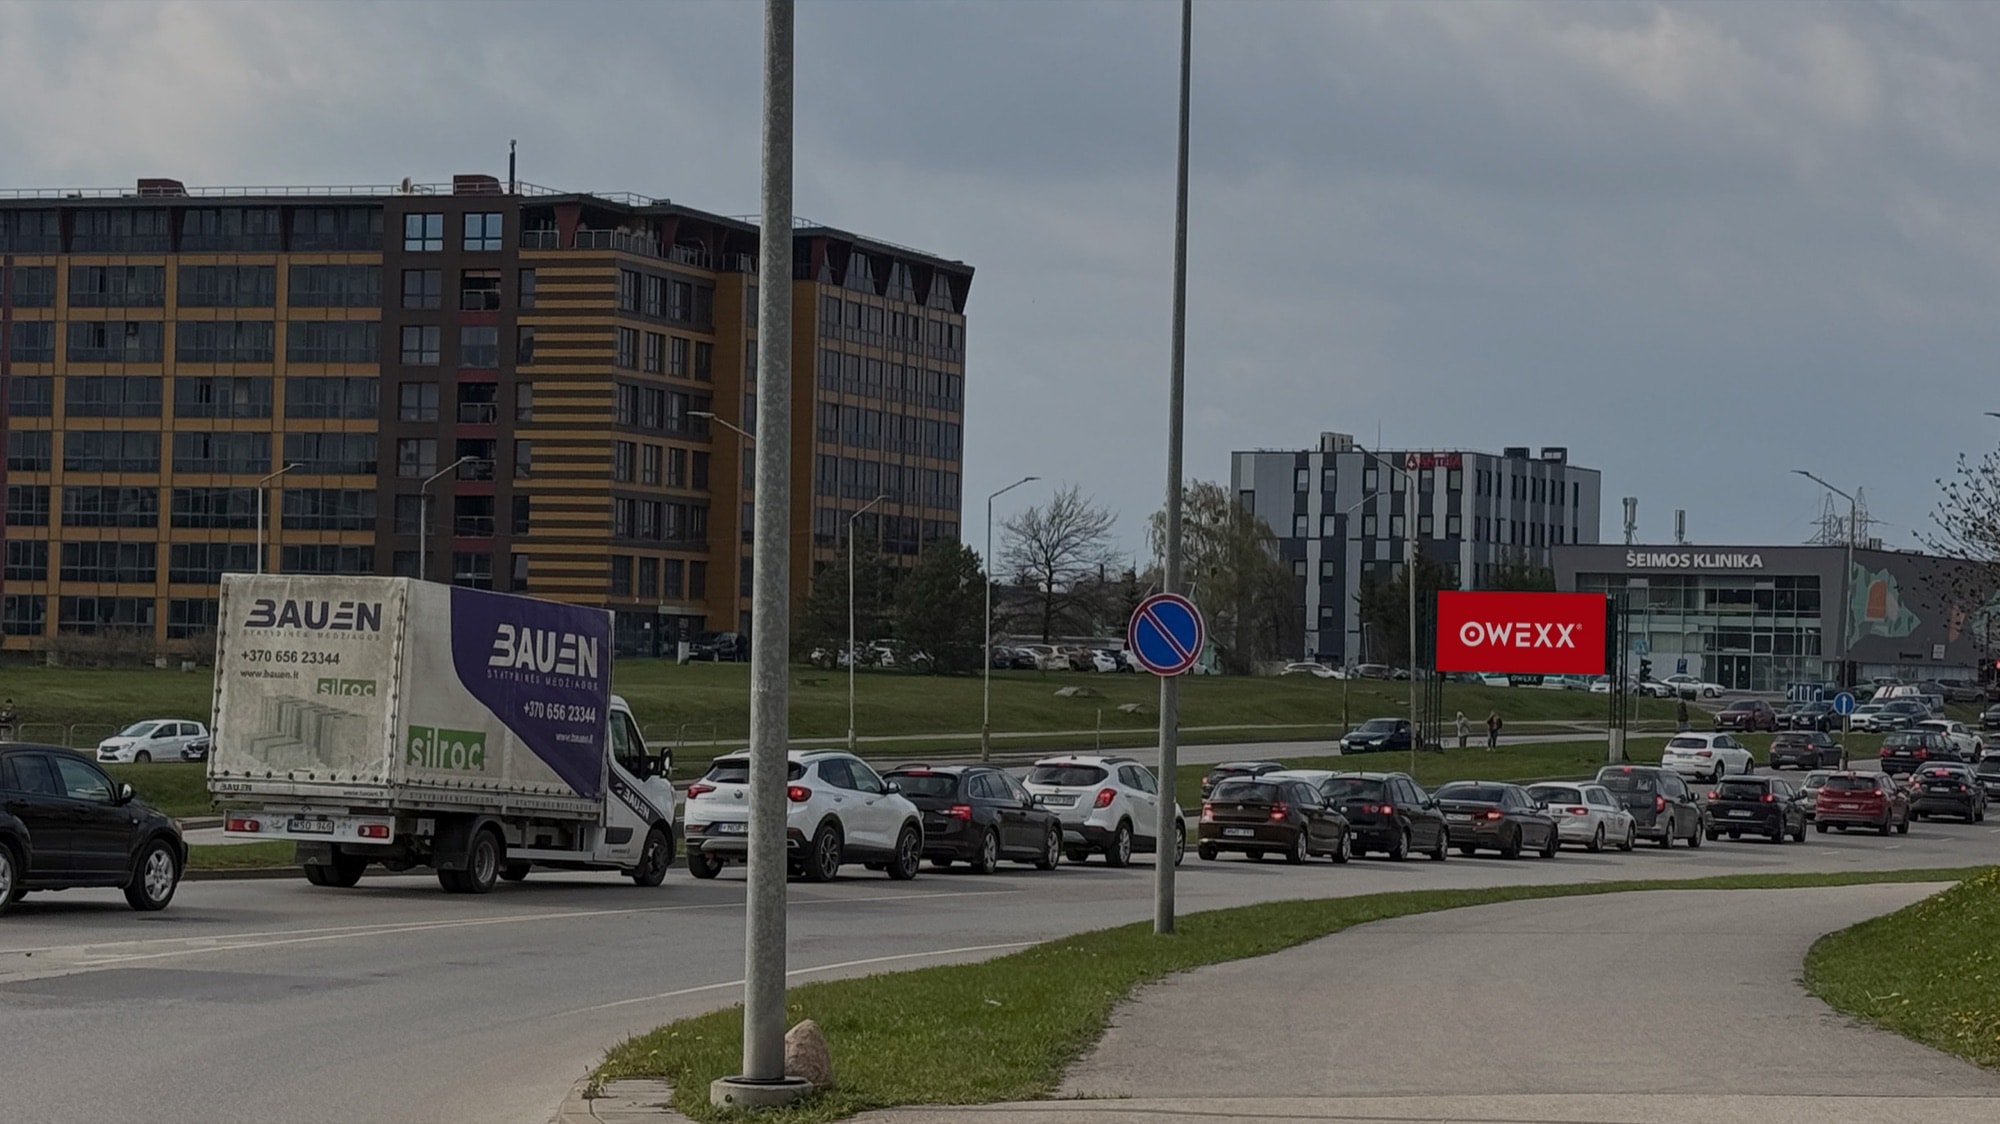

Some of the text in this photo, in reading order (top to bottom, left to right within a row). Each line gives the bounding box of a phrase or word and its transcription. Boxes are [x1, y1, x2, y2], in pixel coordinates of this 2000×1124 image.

[1626, 549, 1763, 568] ŠEIMOS KLINIKA
[244, 598, 382, 632] BAUEN
[241, 650, 340, 665] +370 656 23344
[488, 623, 598, 679] BAUEN
[523, 700, 596, 723] +370 656 23344
